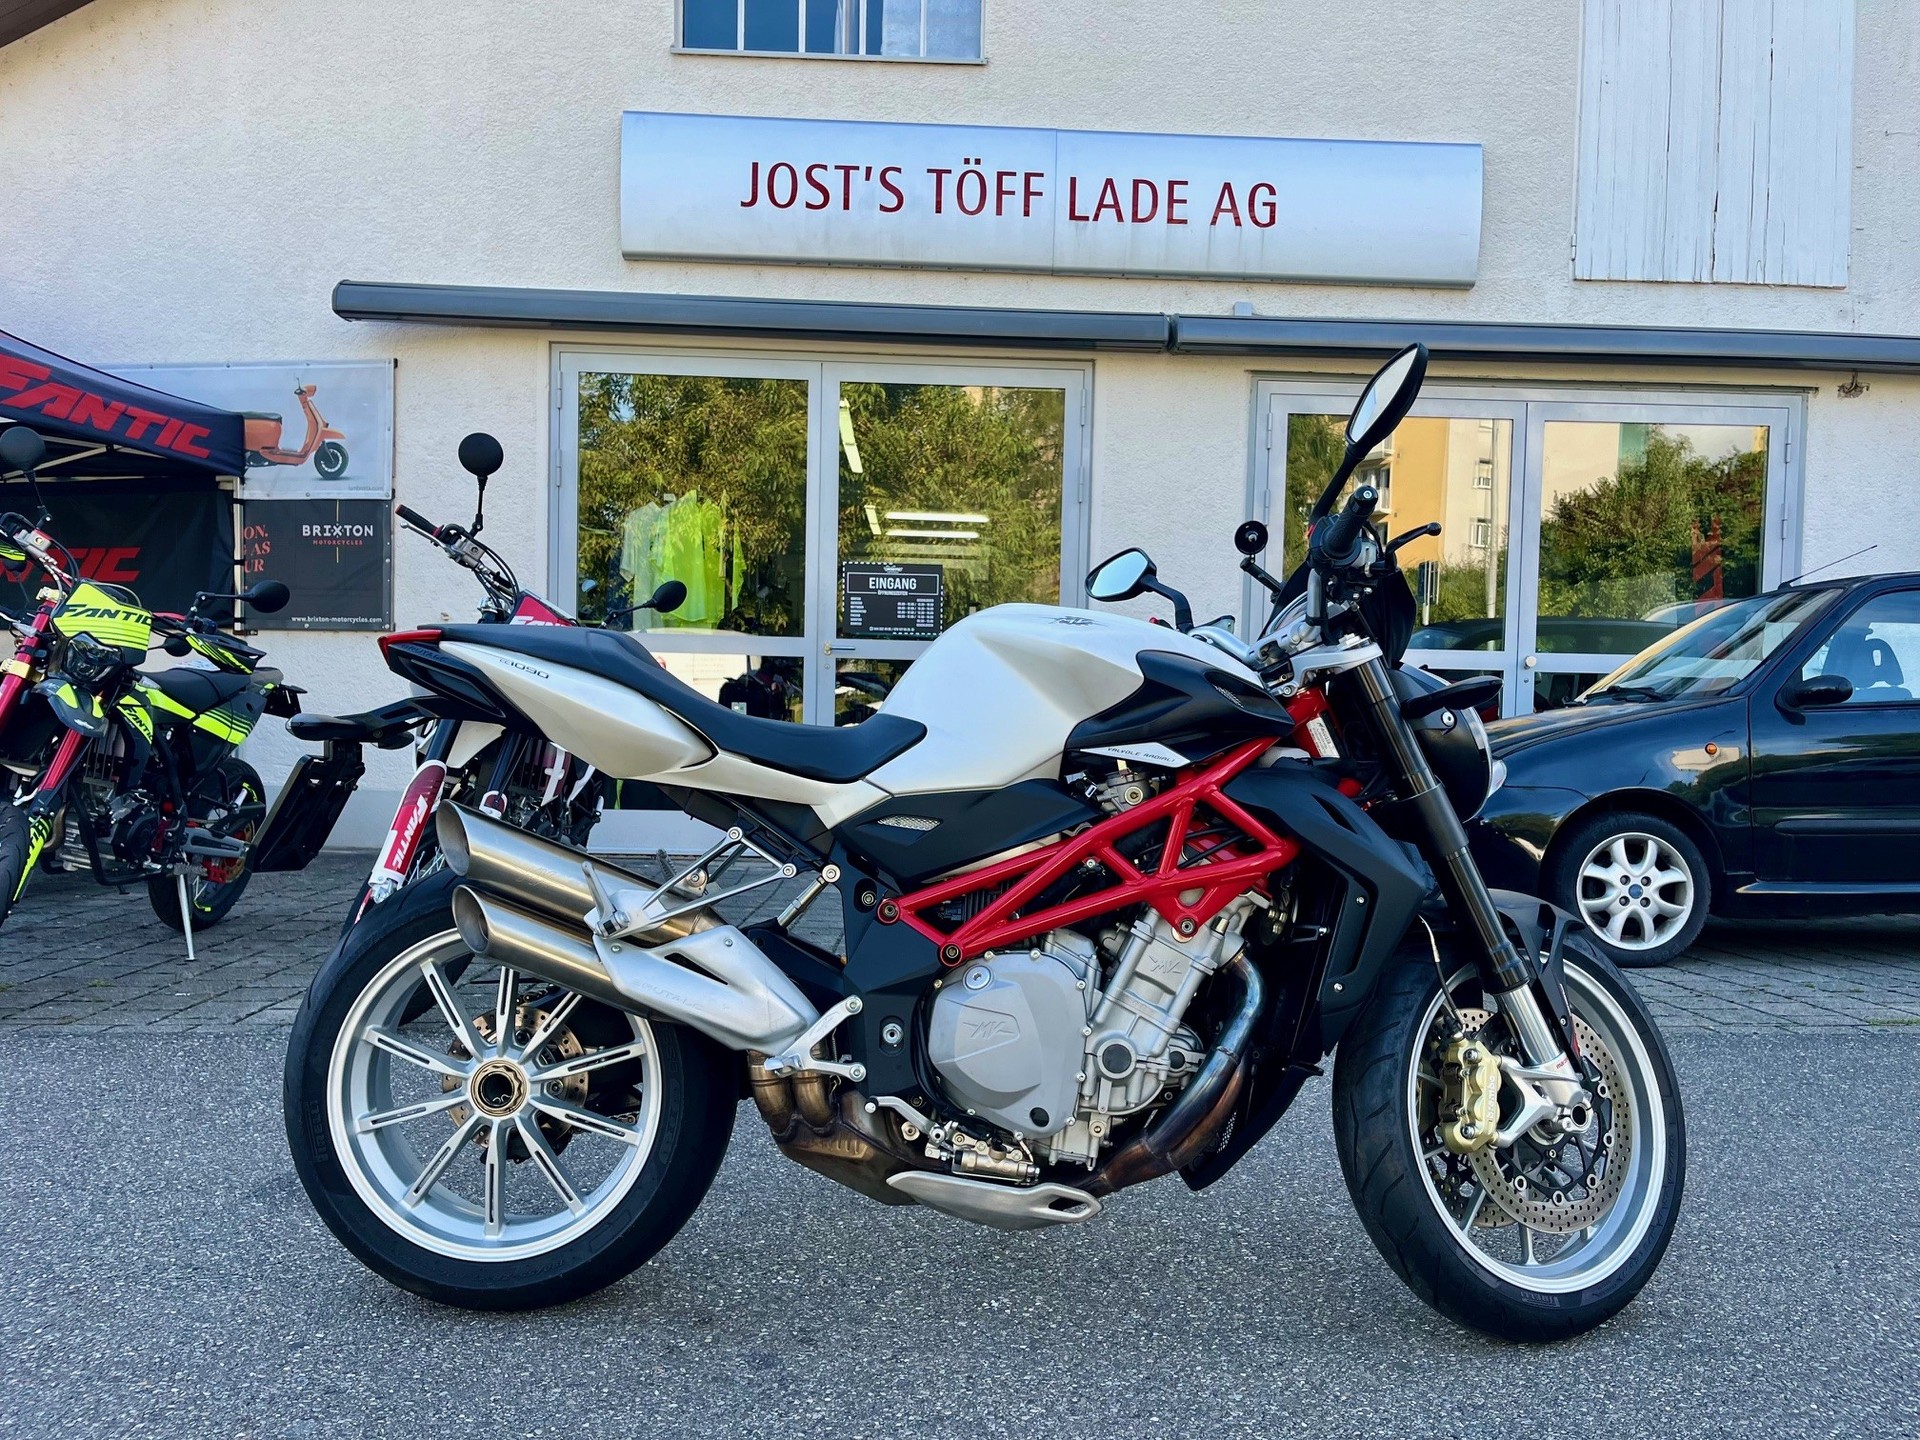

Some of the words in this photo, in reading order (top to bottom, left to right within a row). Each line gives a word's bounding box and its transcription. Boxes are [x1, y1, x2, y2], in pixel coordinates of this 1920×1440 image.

[740, 161, 904, 213] JOST'S
[926, 158, 1045, 217] TÖFF
[1068, 176, 1190, 225] LADE
[1209, 181, 1277, 228] AG
[242, 525, 268, 539] ON.
[302, 524, 374, 537] BRIXTON
[250, 541, 271, 556] AS
[244, 558, 264, 573] UR
[869, 577, 917, 590] EINGANG
[291, 616, 382, 625] www.brixton-motorcycles.com
[1107, 747, 1141, 756] VALVOLE
